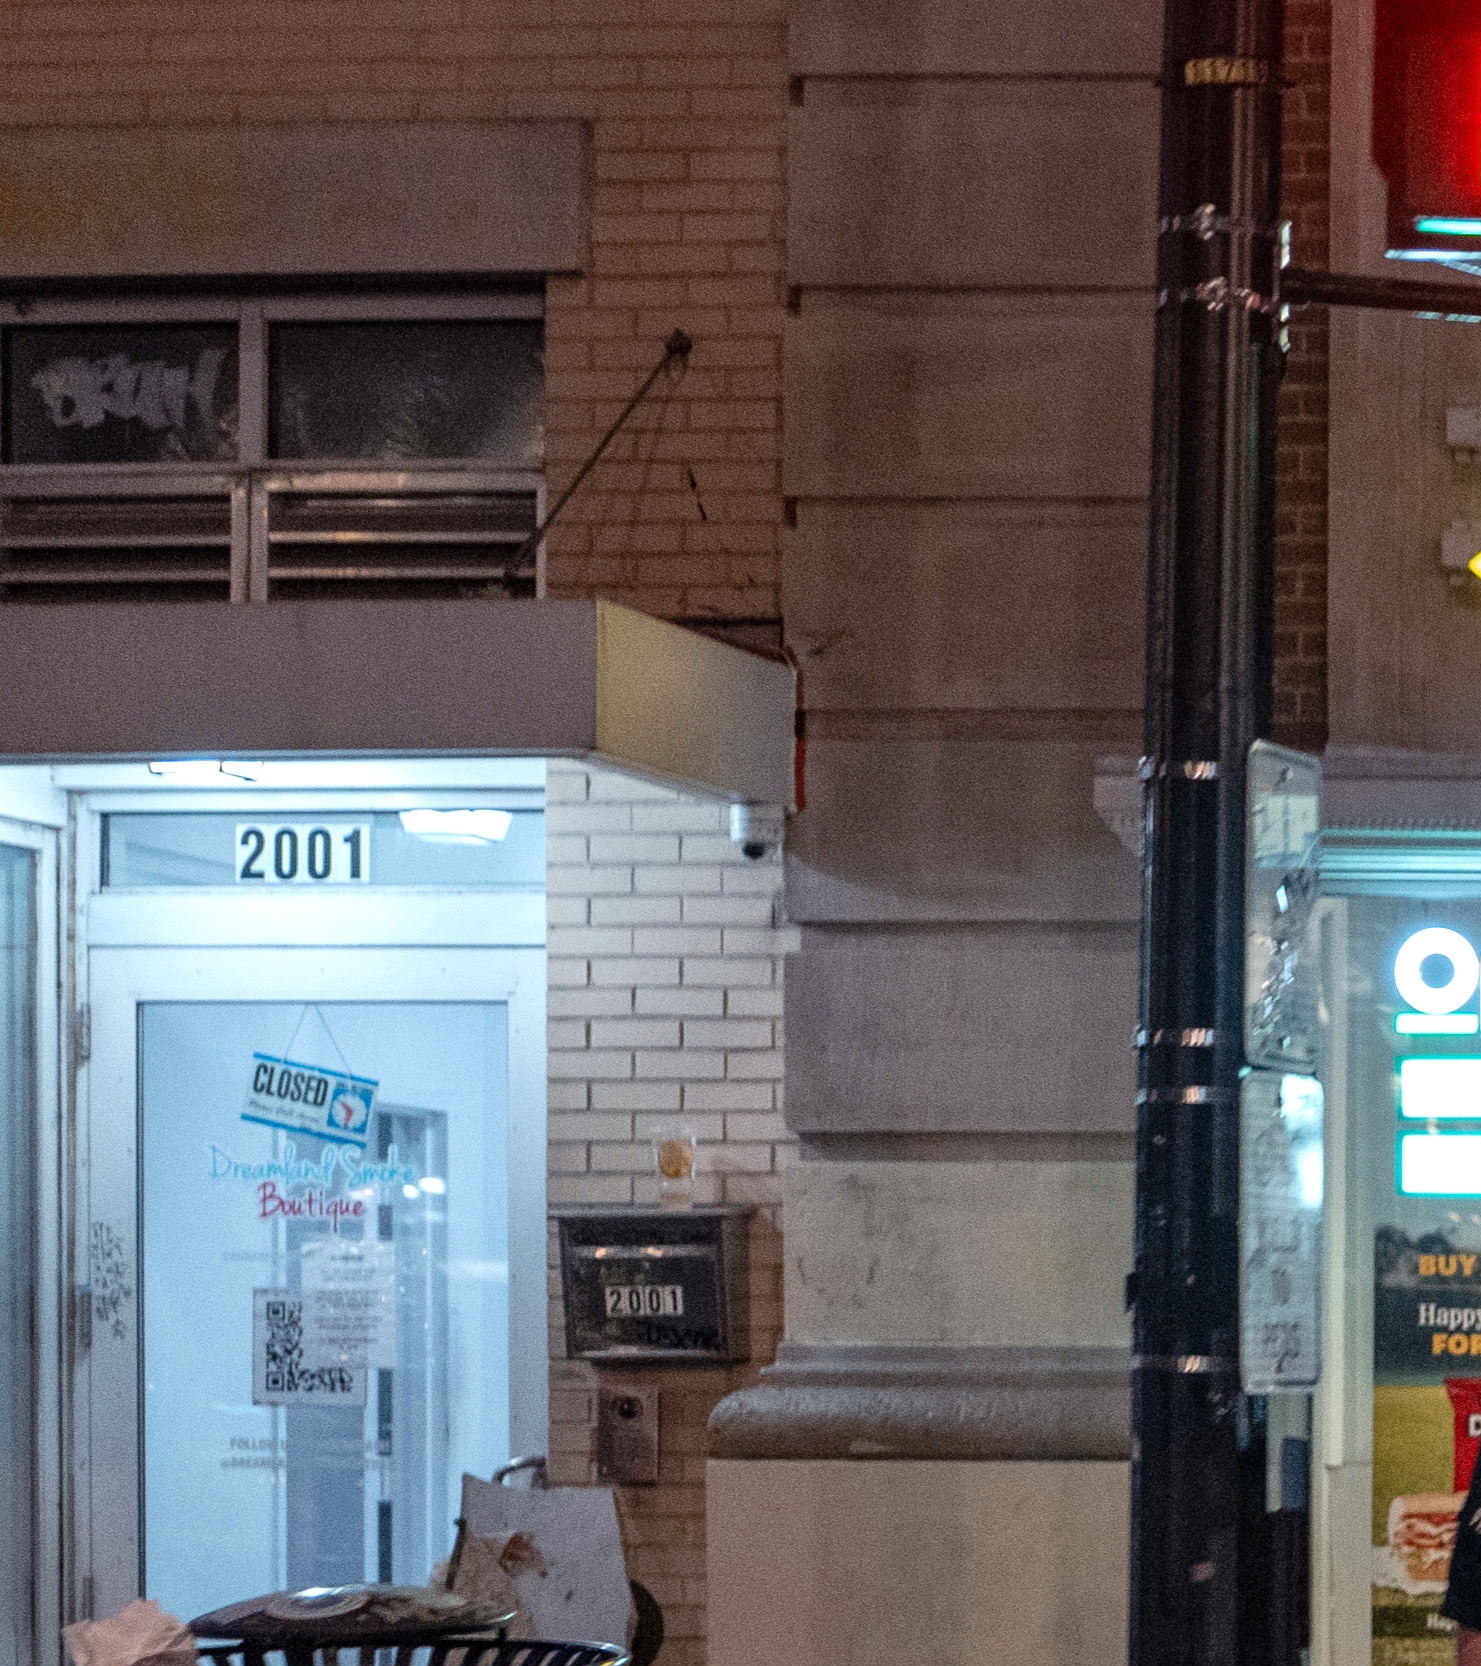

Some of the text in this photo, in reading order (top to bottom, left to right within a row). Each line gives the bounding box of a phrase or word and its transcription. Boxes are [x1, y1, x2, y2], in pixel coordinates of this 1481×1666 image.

[240, 827, 362, 880] 2001
[252, 1062, 330, 1108] CLOSED
[209, 1142, 415, 1188] Dreamland Smoke
[257, 1181, 365, 1233] Boutique
[1418, 1254, 1477, 1277] BUY
[608, 1288, 679, 1314] 2001
